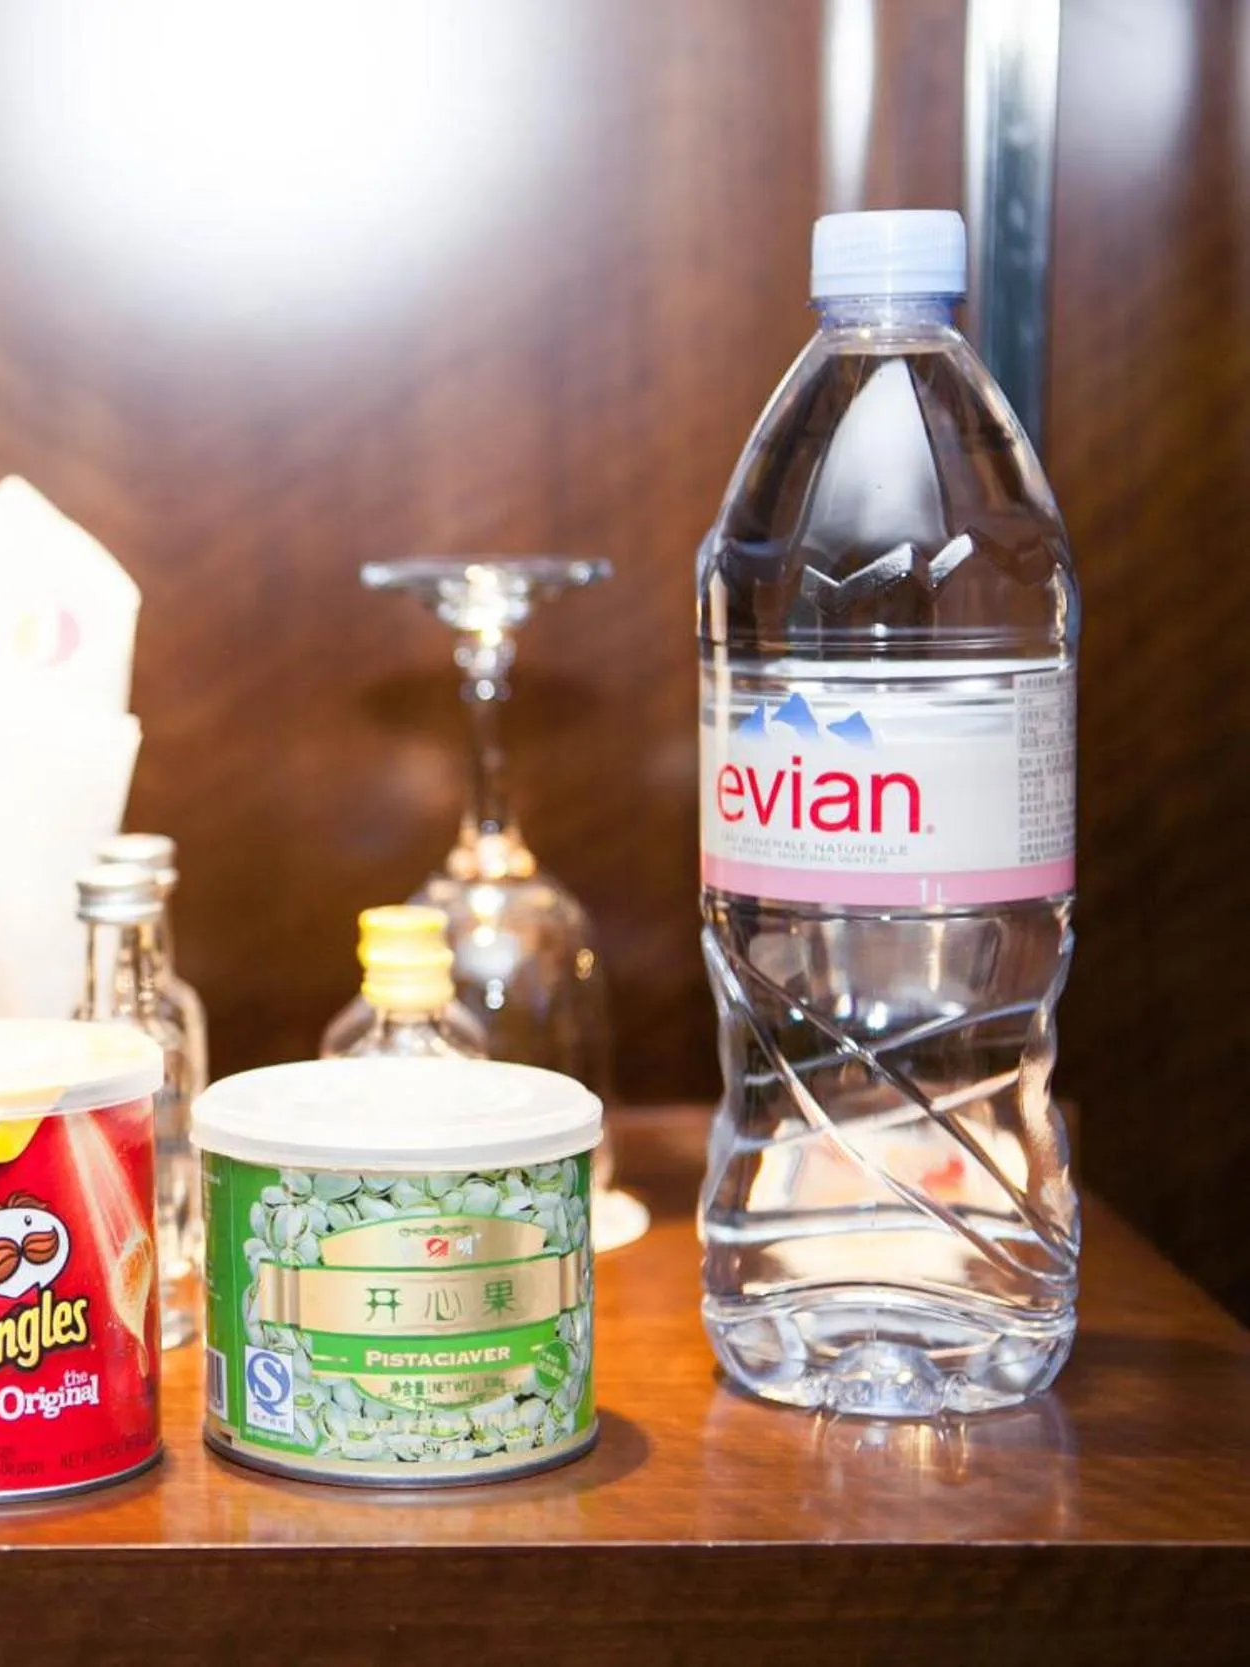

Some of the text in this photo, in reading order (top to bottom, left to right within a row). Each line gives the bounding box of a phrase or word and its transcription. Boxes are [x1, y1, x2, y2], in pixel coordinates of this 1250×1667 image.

[715, 755, 921, 834] evian
[814, 841, 909, 857] NATURELLE
[365, 1279, 516, 1323] 开心果
[365, 1345, 511, 1368] PISTACIAVER
[64, 1369, 88, 1387] the
